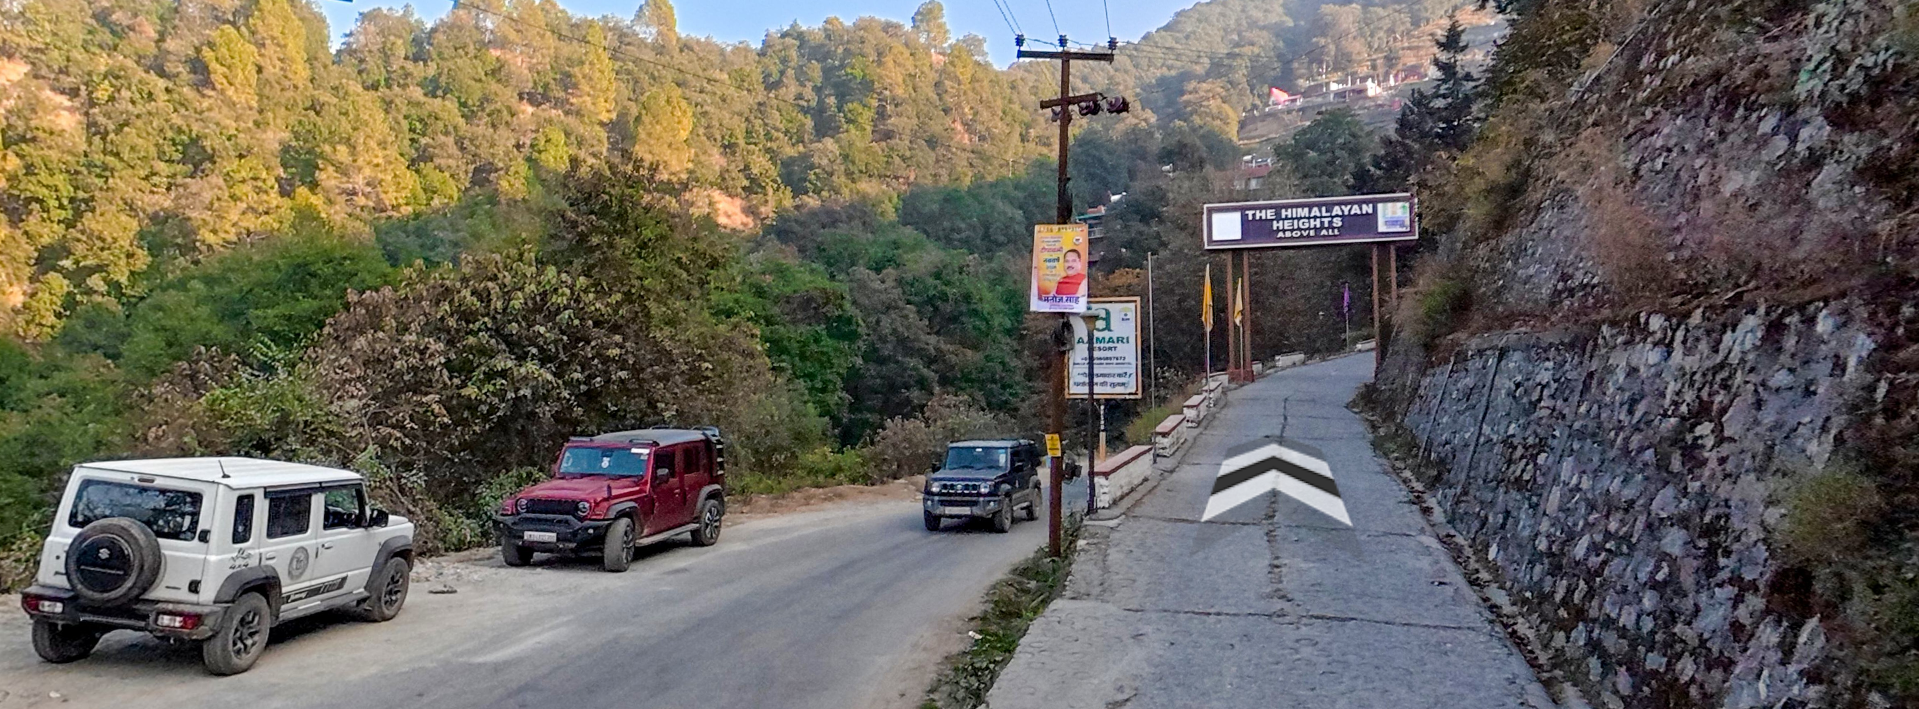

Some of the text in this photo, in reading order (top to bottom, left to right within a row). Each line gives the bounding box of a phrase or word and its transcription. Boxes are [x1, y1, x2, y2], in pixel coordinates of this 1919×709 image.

[1245, 203, 1374, 221] THE HIMALAYAN
[1272, 217, 1343, 231] HEIGHTS
[1276, 228, 1341, 238] ABOVE ALL
[1076, 336, 1130, 344] AMARI
